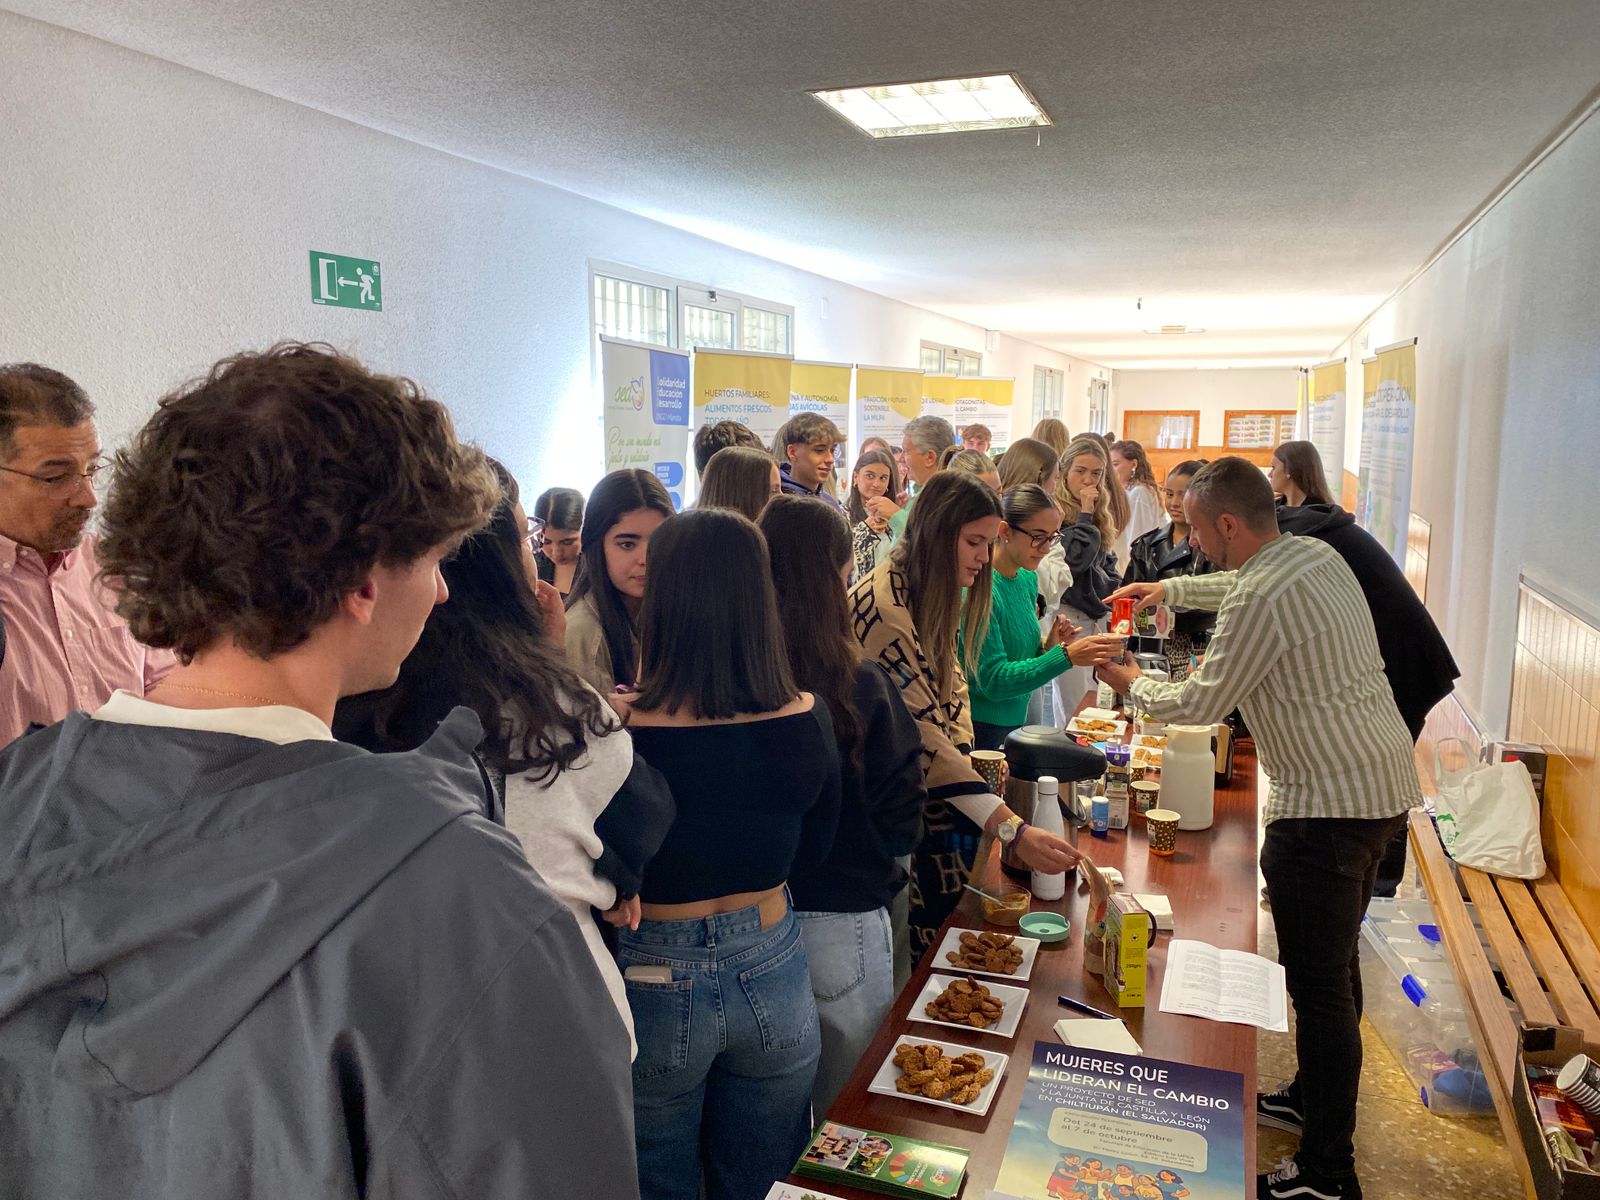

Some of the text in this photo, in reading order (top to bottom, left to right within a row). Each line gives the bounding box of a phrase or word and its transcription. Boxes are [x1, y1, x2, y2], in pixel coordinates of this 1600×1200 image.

[704, 389, 734, 398] HUERTOS
[704, 404, 742, 413] ALIMENTOS
[1046, 1051, 1168, 1083] MUJERES QUE
[1043, 1069, 1229, 1110] LIDERAN EL CAMBIO
[1060, 1084, 1115, 1099] PROYECTO
[1134, 1098, 1156, 1107] SED
[1055, 1097, 1118, 1115] CHILTIUPÁN
[1122, 1110, 1138, 1118] (EL
[1141, 1113, 1207, 1131] SALVADOR)
[1061, 1091, 1098, 1103] JUNTA
[1117, 1101, 1169, 1116] CASTILLA
[1180, 1113, 1211, 1124] LEÓN
[1063, 1117, 1080, 1125] Del
[1115, 1127, 1172, 1143] septiembre
[1098, 1132, 1138, 1143] octubre
